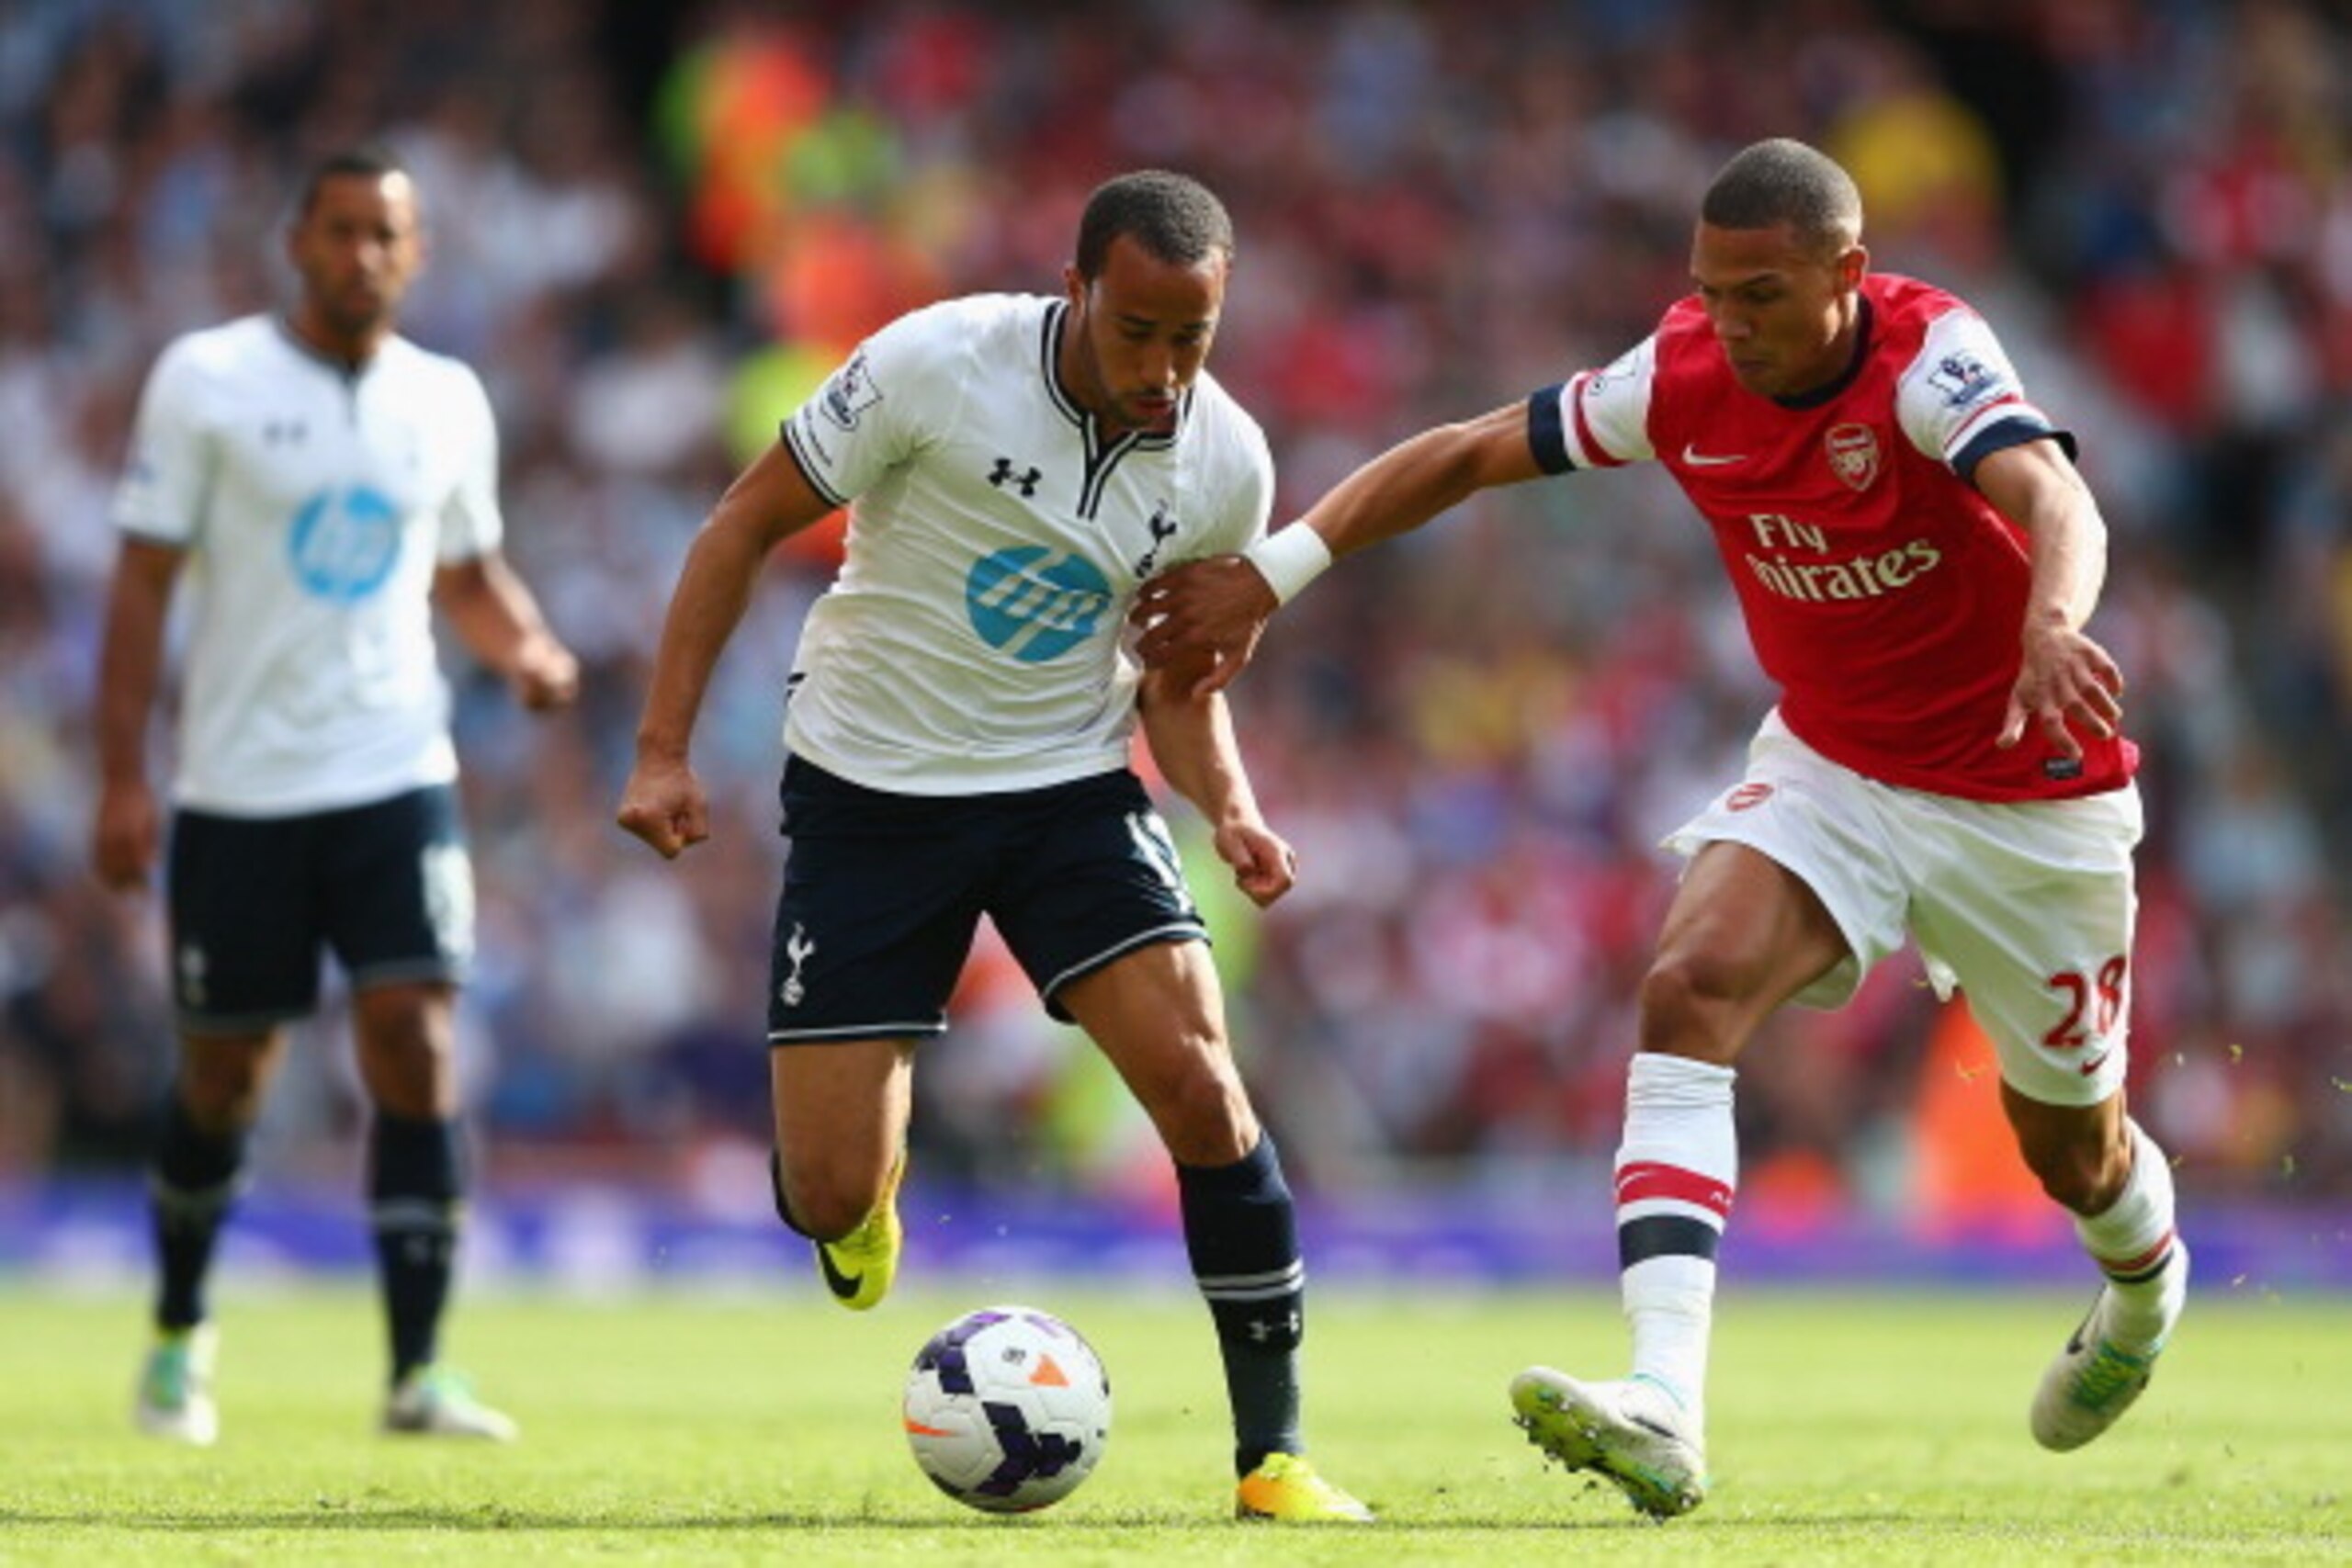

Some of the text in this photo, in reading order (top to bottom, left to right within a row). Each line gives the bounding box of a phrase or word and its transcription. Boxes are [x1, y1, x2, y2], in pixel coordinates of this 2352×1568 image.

[1749, 513, 1828, 554] Fly
[1746, 539, 1941, 602] mirates
[2041, 954, 2127, 1047] 28
